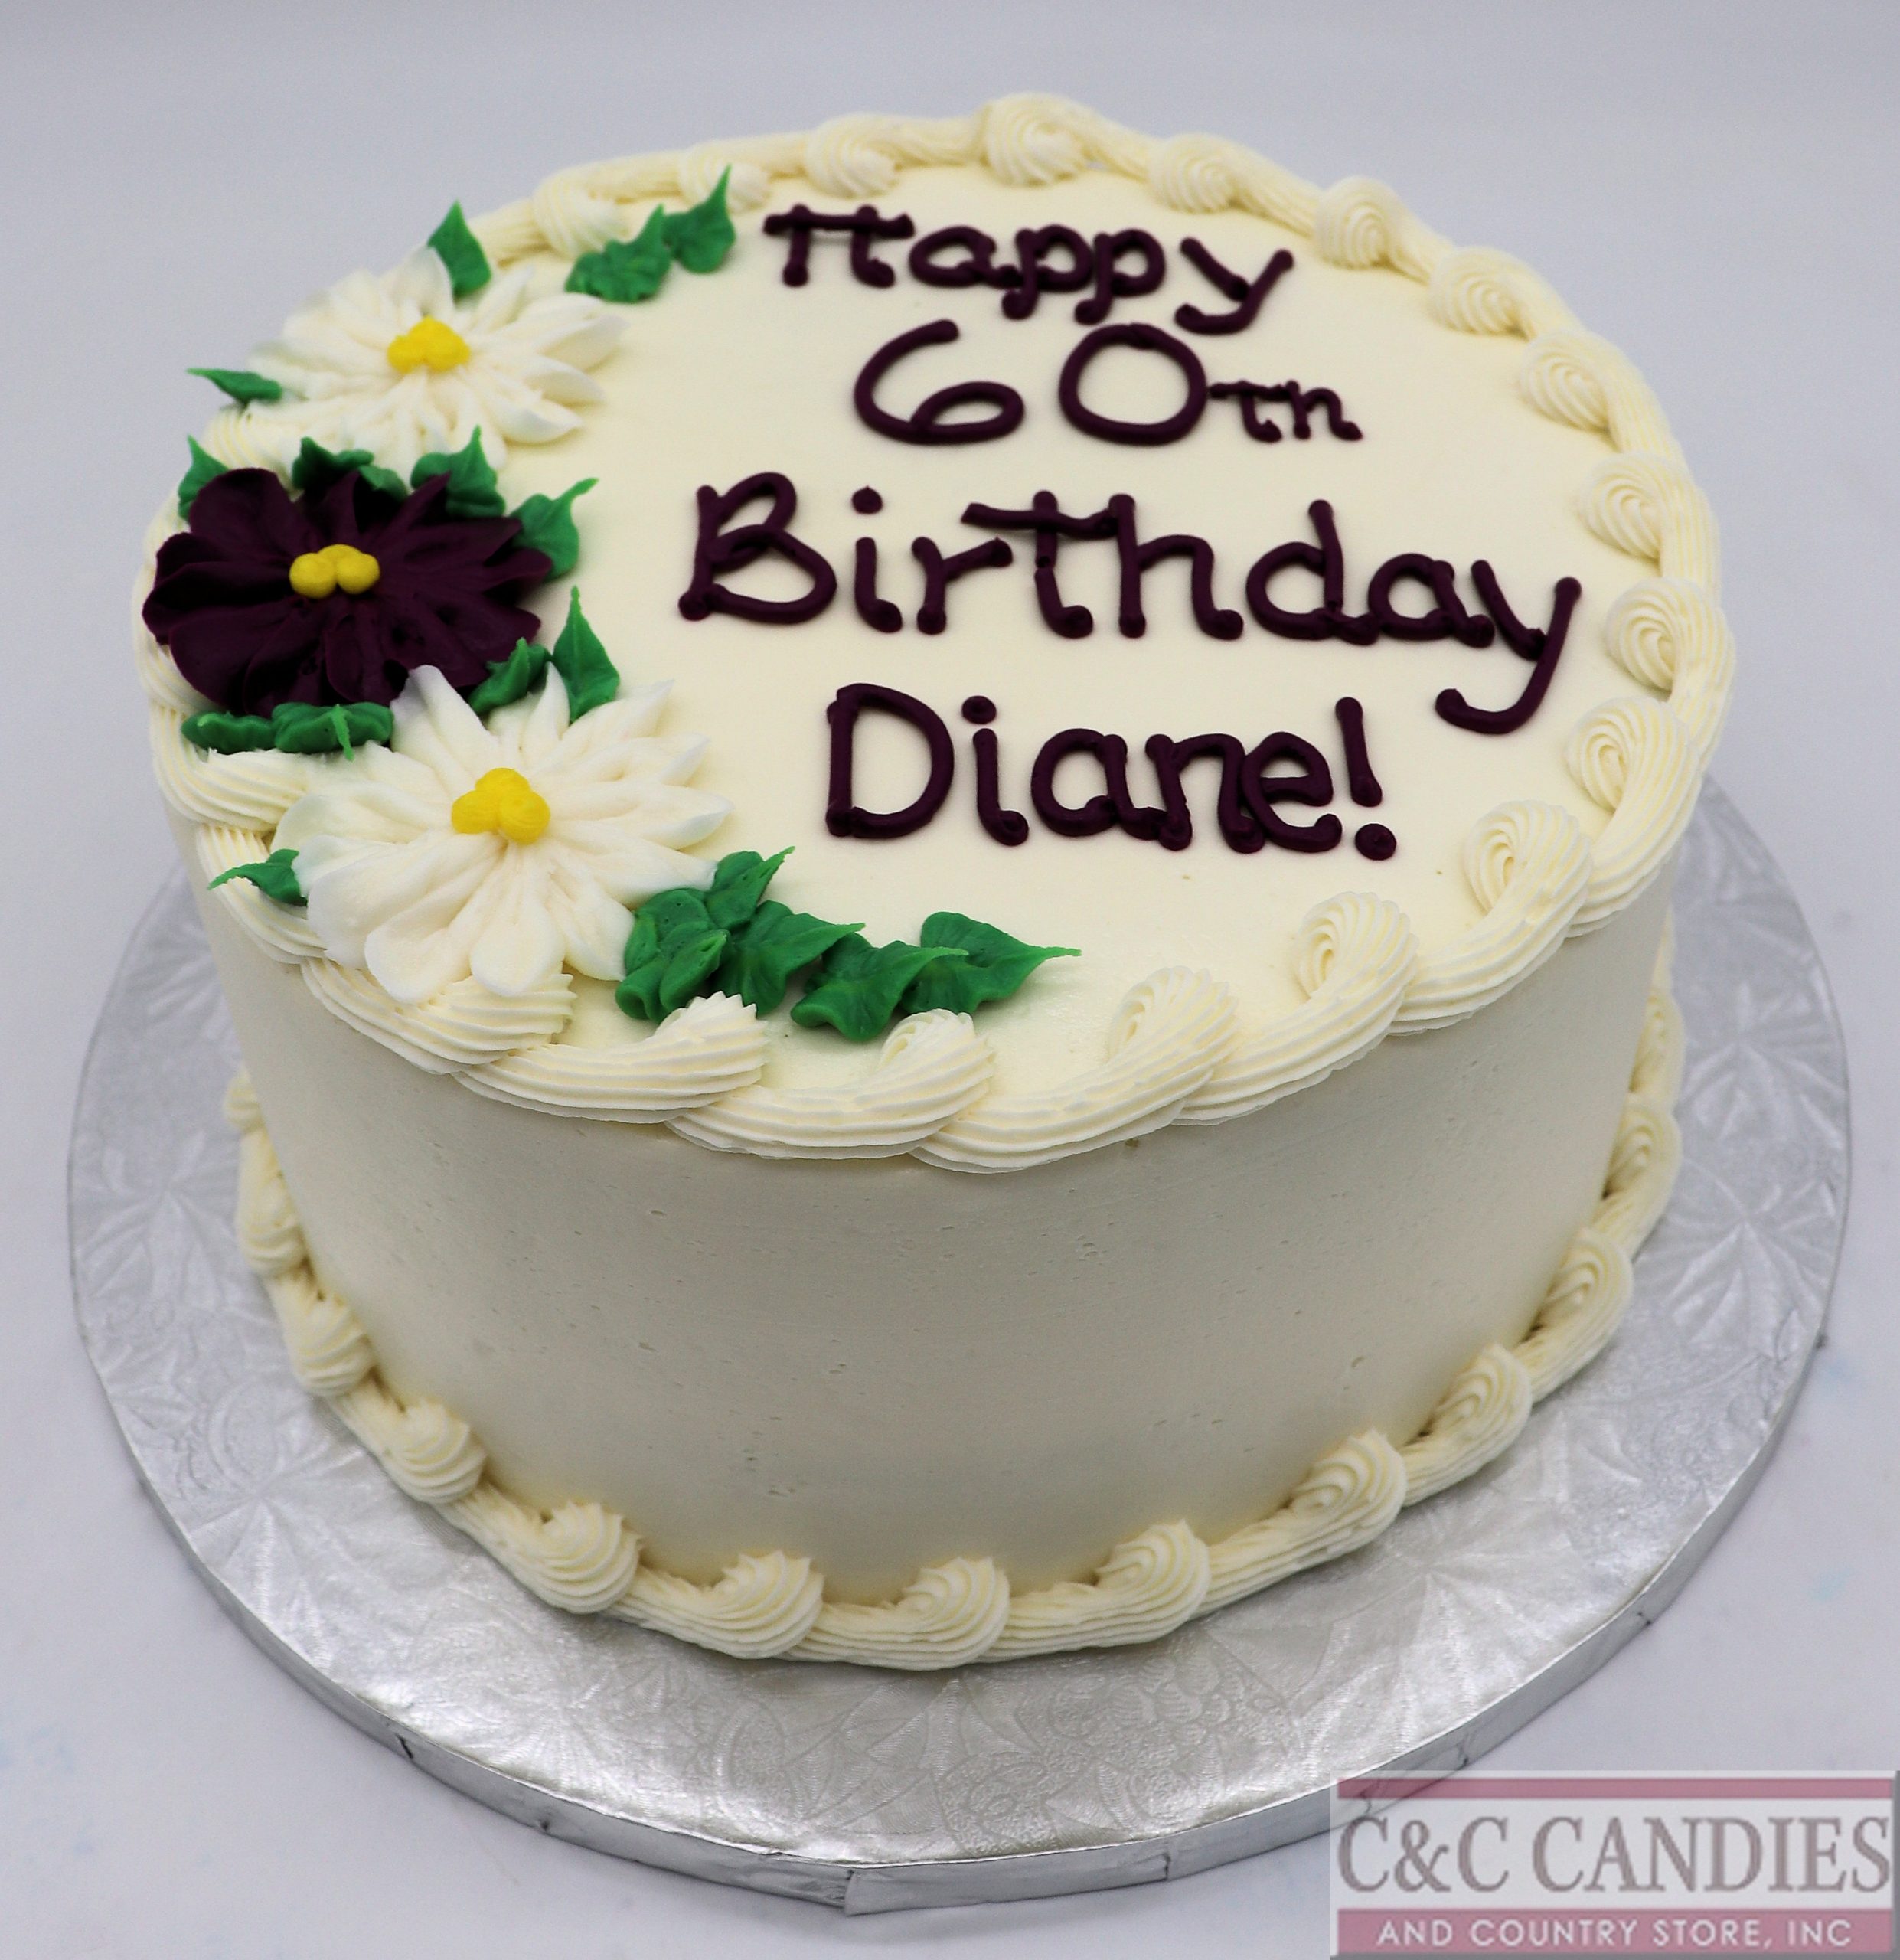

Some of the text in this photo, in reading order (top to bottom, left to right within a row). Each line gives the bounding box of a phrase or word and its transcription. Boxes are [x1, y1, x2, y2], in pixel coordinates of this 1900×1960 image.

[762, 204, 1294, 336] Happy
[853, 318, 1363, 448] 60th
[677, 471, 1582, 737] Birthday
[824, 681, 1397, 861] Diane!
